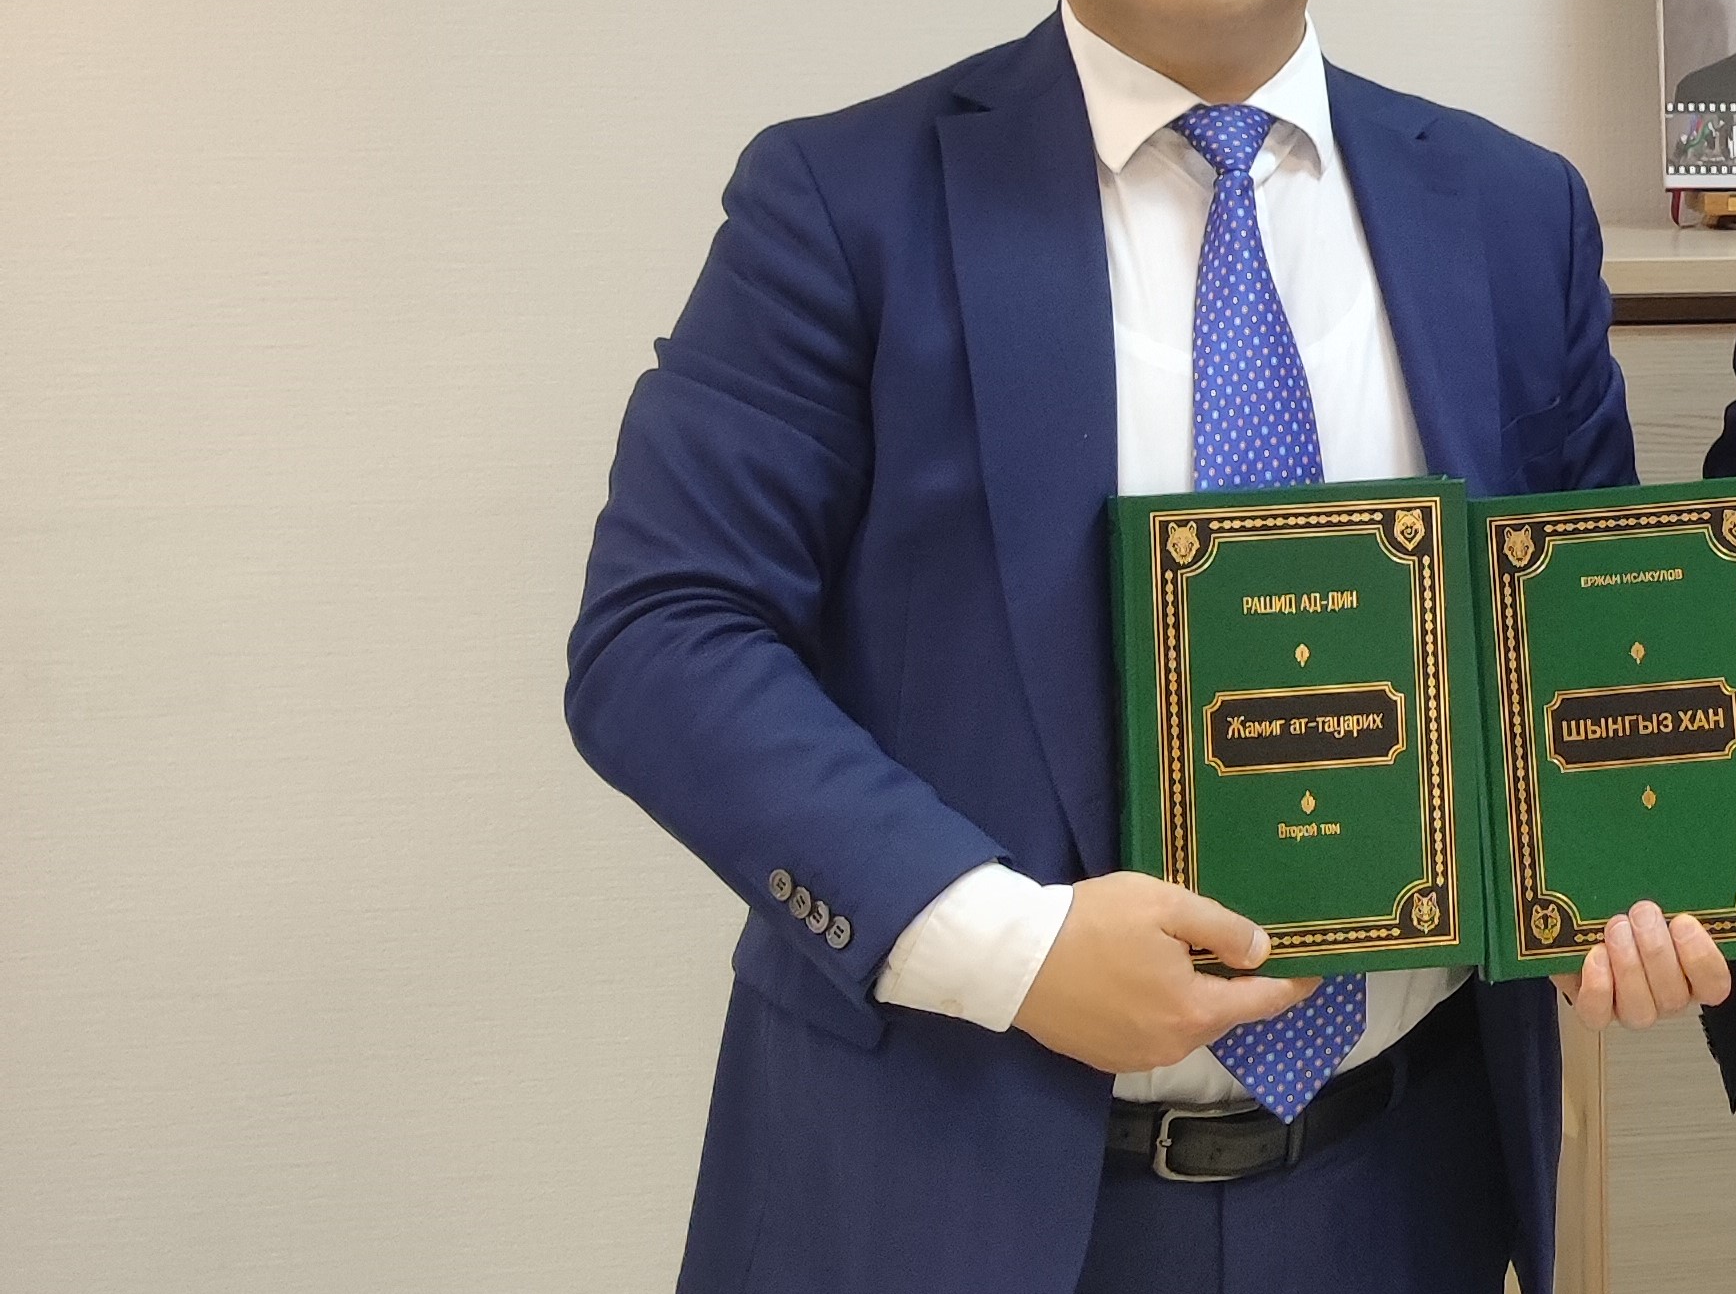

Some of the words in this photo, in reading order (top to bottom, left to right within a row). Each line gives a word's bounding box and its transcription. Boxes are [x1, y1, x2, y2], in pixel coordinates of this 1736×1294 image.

[1581, 573, 1621, 588] ЕРЖАН
[1622, 568, 1683, 584] ИСАКУЛОВ
[1242, 593, 1297, 615] РАШИД
[1300, 590, 1358, 613] АД-ДИН
[1226, 715, 1285, 739] Жамиг
[1289, 712, 1384, 739] ат-тауарих
[1561, 712, 1674, 742] ШЫНГЫЗ
[1677, 707, 1725, 732] ХАН
[1278, 822, 1318, 842] Второй
[1319, 822, 1341, 835] том
